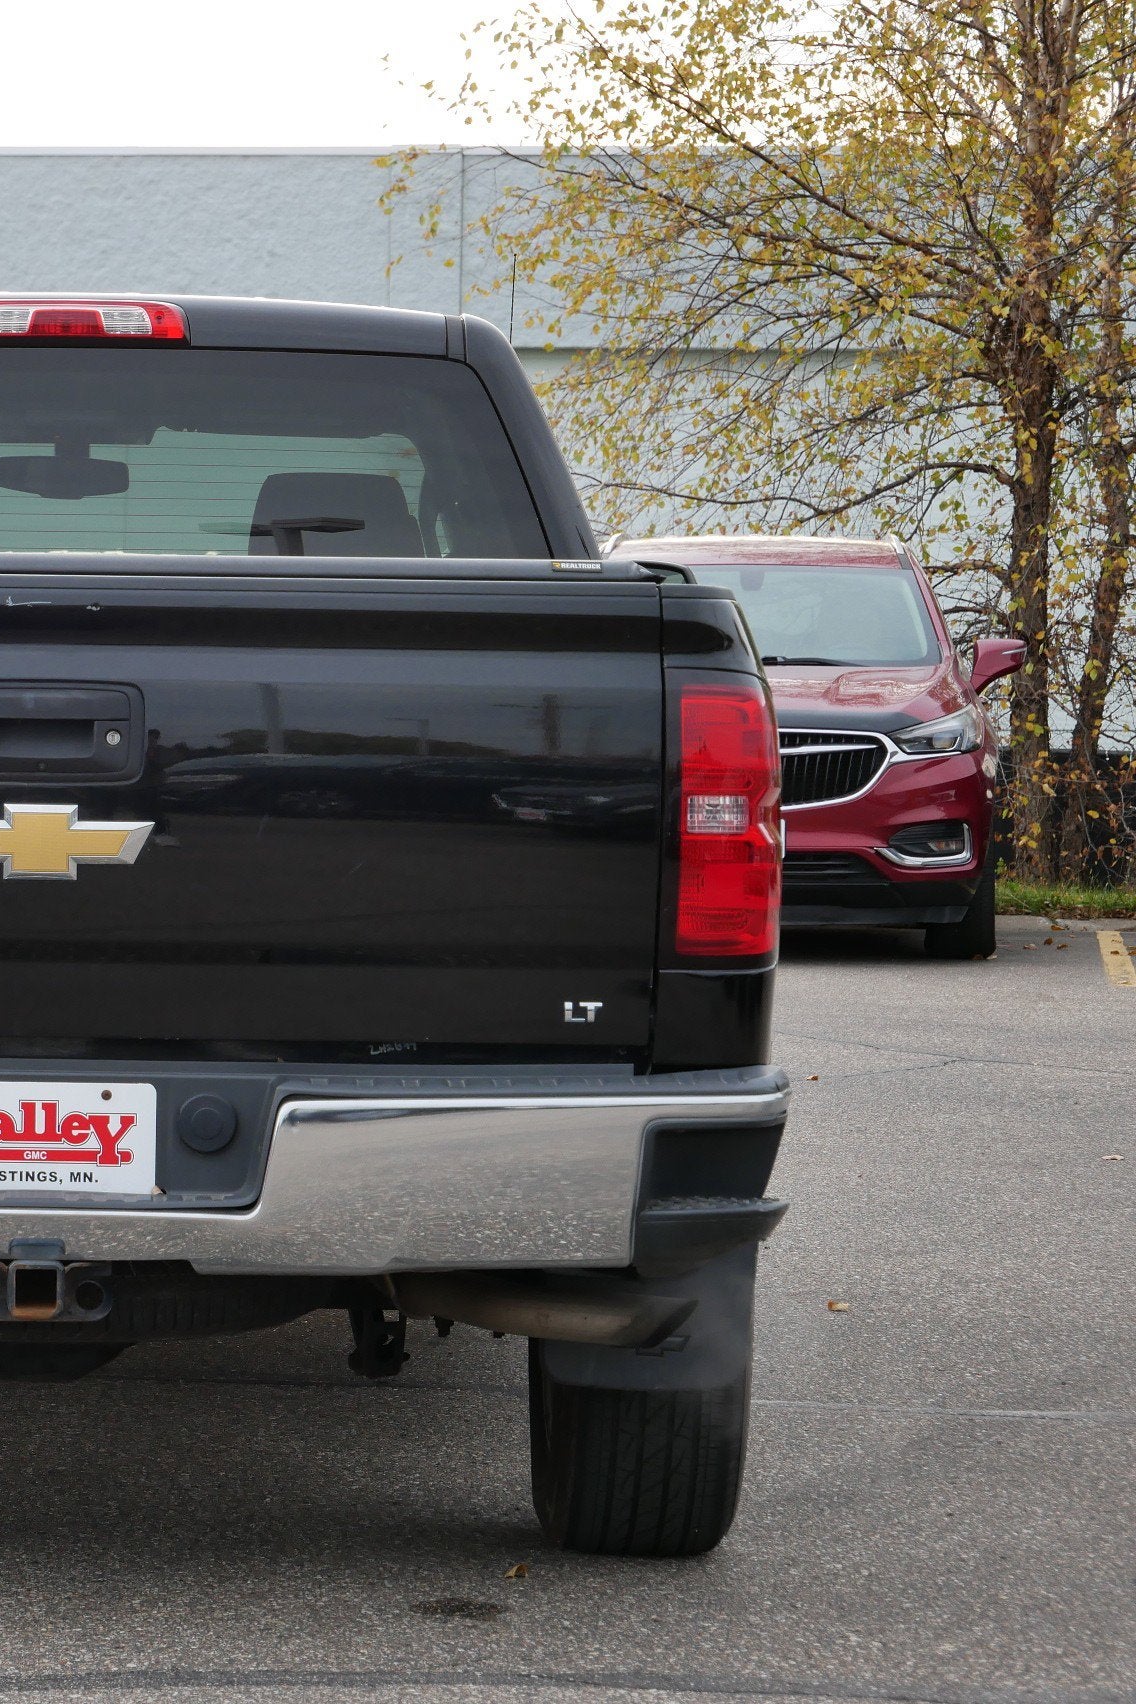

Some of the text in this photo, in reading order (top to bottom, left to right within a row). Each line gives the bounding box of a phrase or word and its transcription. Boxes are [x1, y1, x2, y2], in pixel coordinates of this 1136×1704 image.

[564, 1001, 603, 1023] LT
[23, 1150, 48, 1161] GMC
[70, 1172, 99, 1184] MN.
